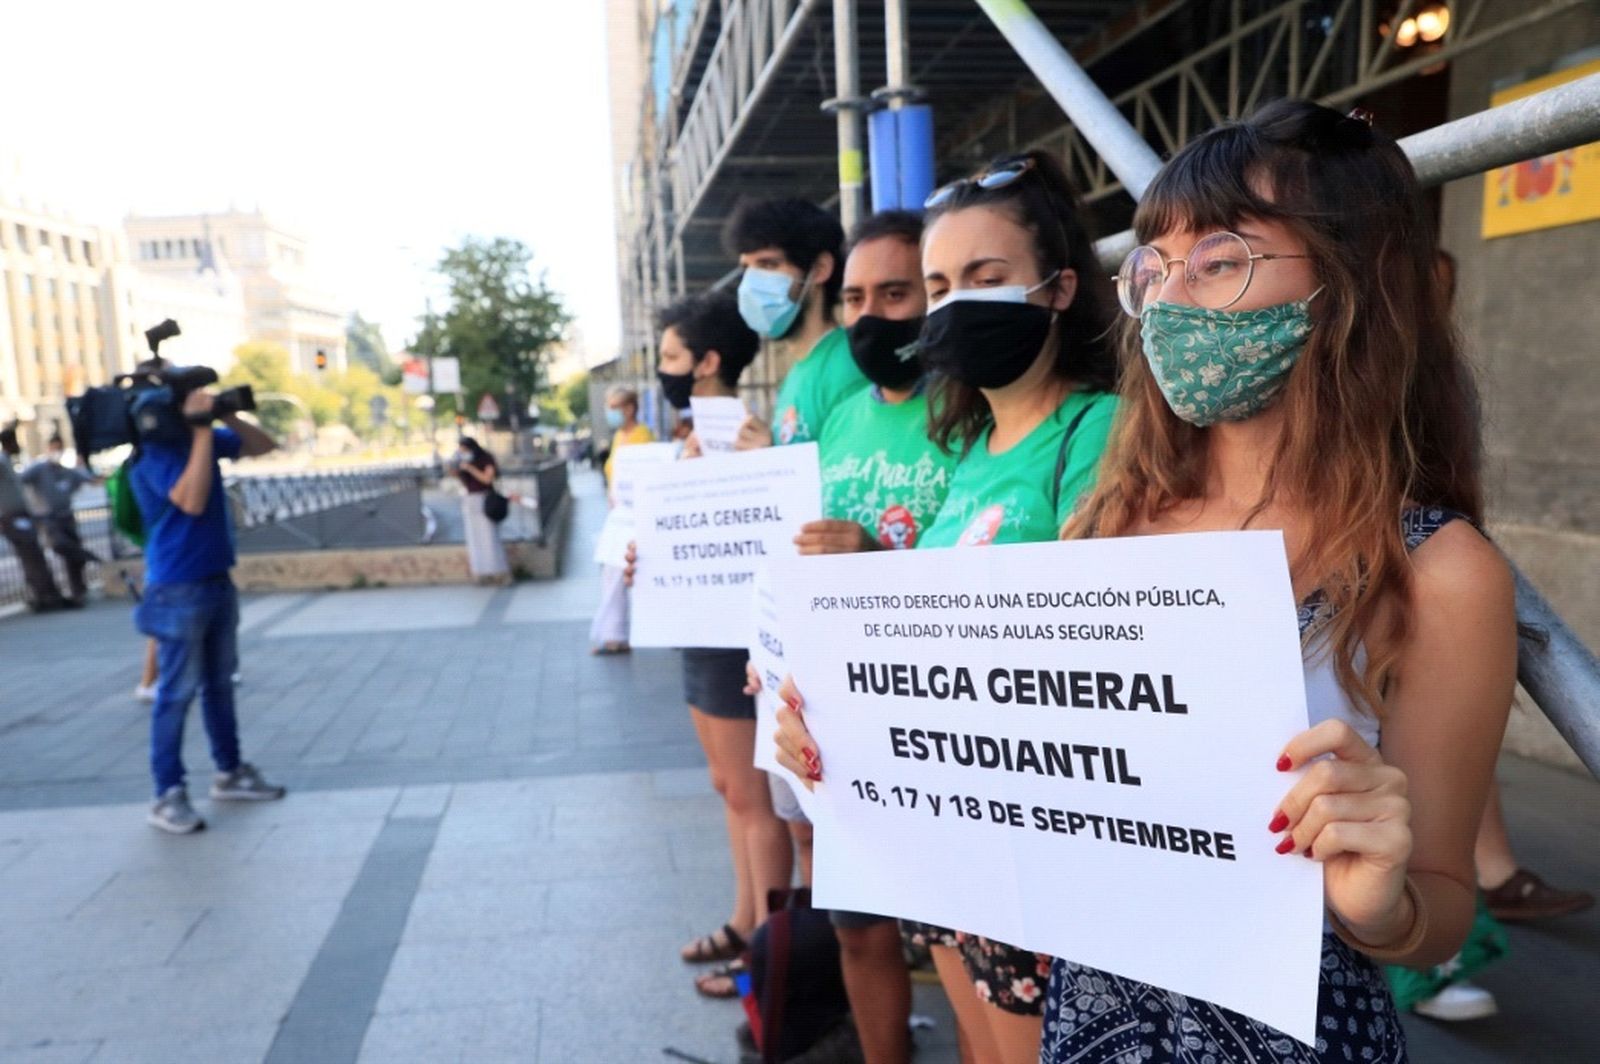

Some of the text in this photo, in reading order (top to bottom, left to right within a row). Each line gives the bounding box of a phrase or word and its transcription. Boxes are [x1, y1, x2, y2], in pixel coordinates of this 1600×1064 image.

[655, 506, 782, 531] HUELGA GENERAL
[672, 539, 768, 561] ESTUDIANTIL
[727, 571, 755, 585] SEPT
[811, 586, 1225, 611] ¡POR NUESTRO DERECHO A UNA EDUCACIÓN PÚBLICA,
[864, 624, 1143, 640] DE CALIDAD Y UNAS AULAS SEGURAS!
[847, 662, 1188, 714] HUELGA GENERAL
[890, 727, 1141, 786] ESTUDIANTIL
[852, 780, 886, 806] 16,
[891, 786, 917, 808] 17
[949, 795, 982, 820] 18
[988, 800, 1024, 827] DE
[1032, 807, 1236, 860] SEPTIEMBRE
